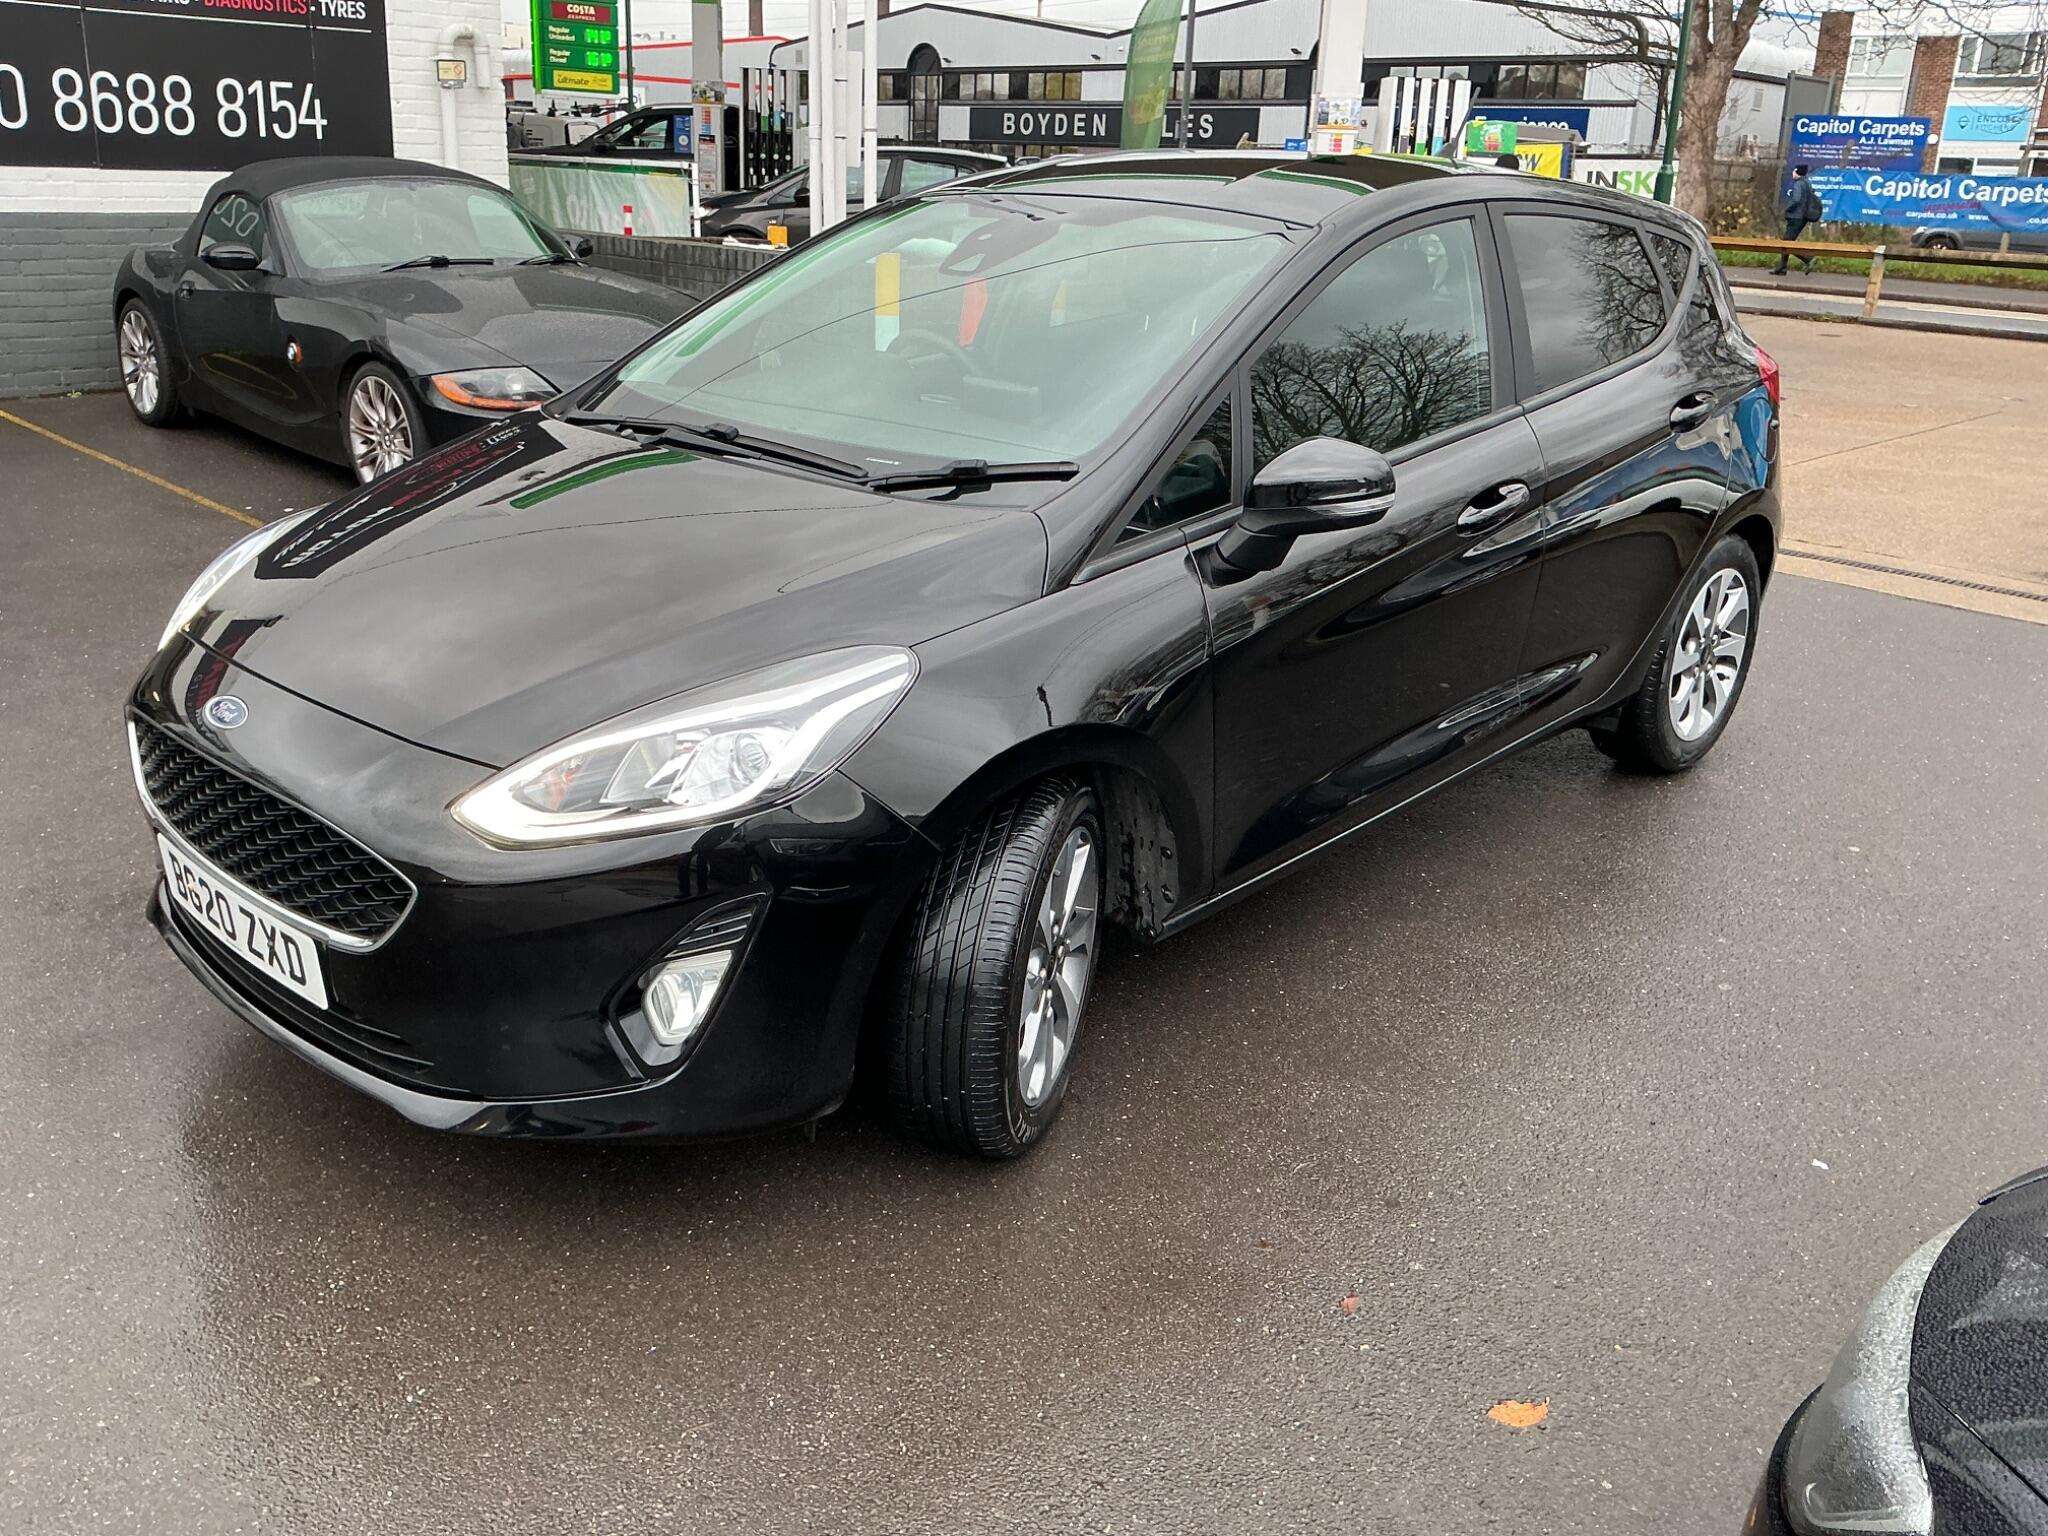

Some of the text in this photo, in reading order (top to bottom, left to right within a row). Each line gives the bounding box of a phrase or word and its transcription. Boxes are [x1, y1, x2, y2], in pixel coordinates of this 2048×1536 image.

[319, 0, 366, 19] TYRES
[567, 4, 596, 14] COSTA
[548, 25, 570, 34] Regular
[549, 48, 570, 56] Regular
[52, 67, 196, 136] 8688
[216, 77, 328, 140] 8154
[1002, 112, 1107, 137] BOYDEN
[1796, 117, 1925, 138] Capitol Carpets
[1878, 136, 1914, 146] Lawman
[1586, 170, 1657, 195] INSK
[1865, 174, 1951, 202] Capitol
[168, 848, 307, 987] BG20 ZXD
